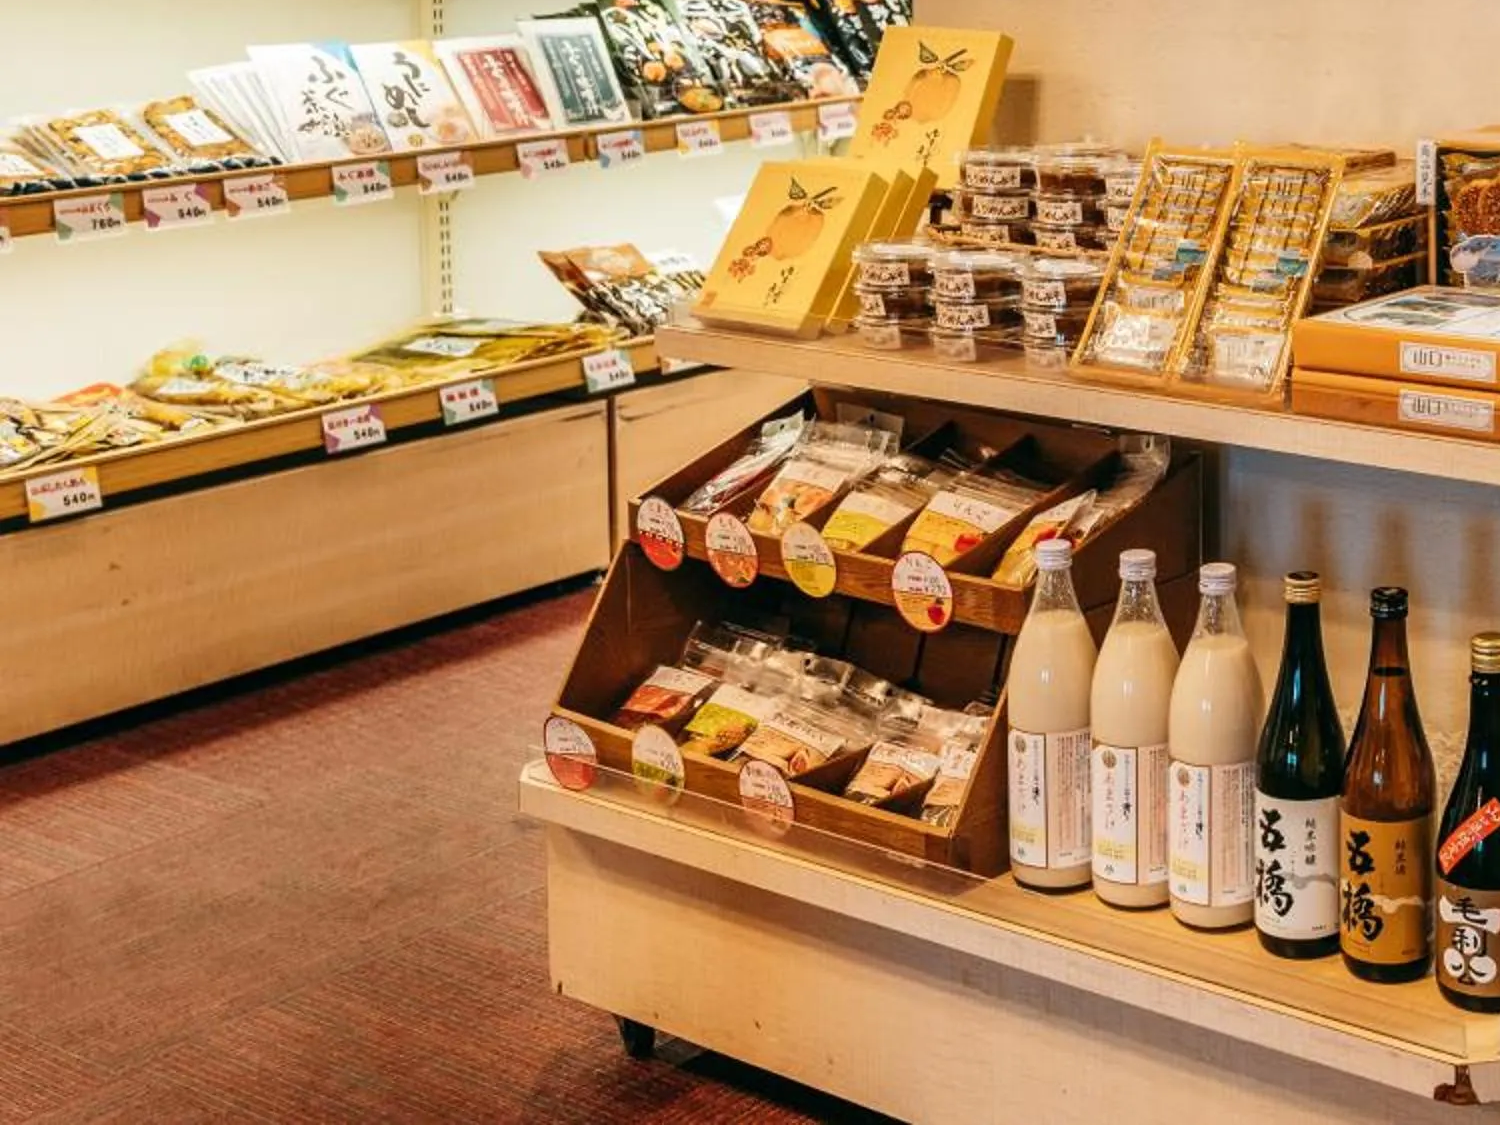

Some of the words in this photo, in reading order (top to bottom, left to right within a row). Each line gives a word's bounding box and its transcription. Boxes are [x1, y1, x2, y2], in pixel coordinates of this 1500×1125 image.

[1412, 348, 1443, 367] 山口
[63, 491, 95, 506] 540円
[1255, 808, 1294, 917] 五橋
[1304, 817, 1316, 865] 純米吟醸
[1394, 838, 1407, 875] 純米酒
[1342, 830, 1384, 942] 五橋
[1451, 897, 1488, 986] 毛利公
